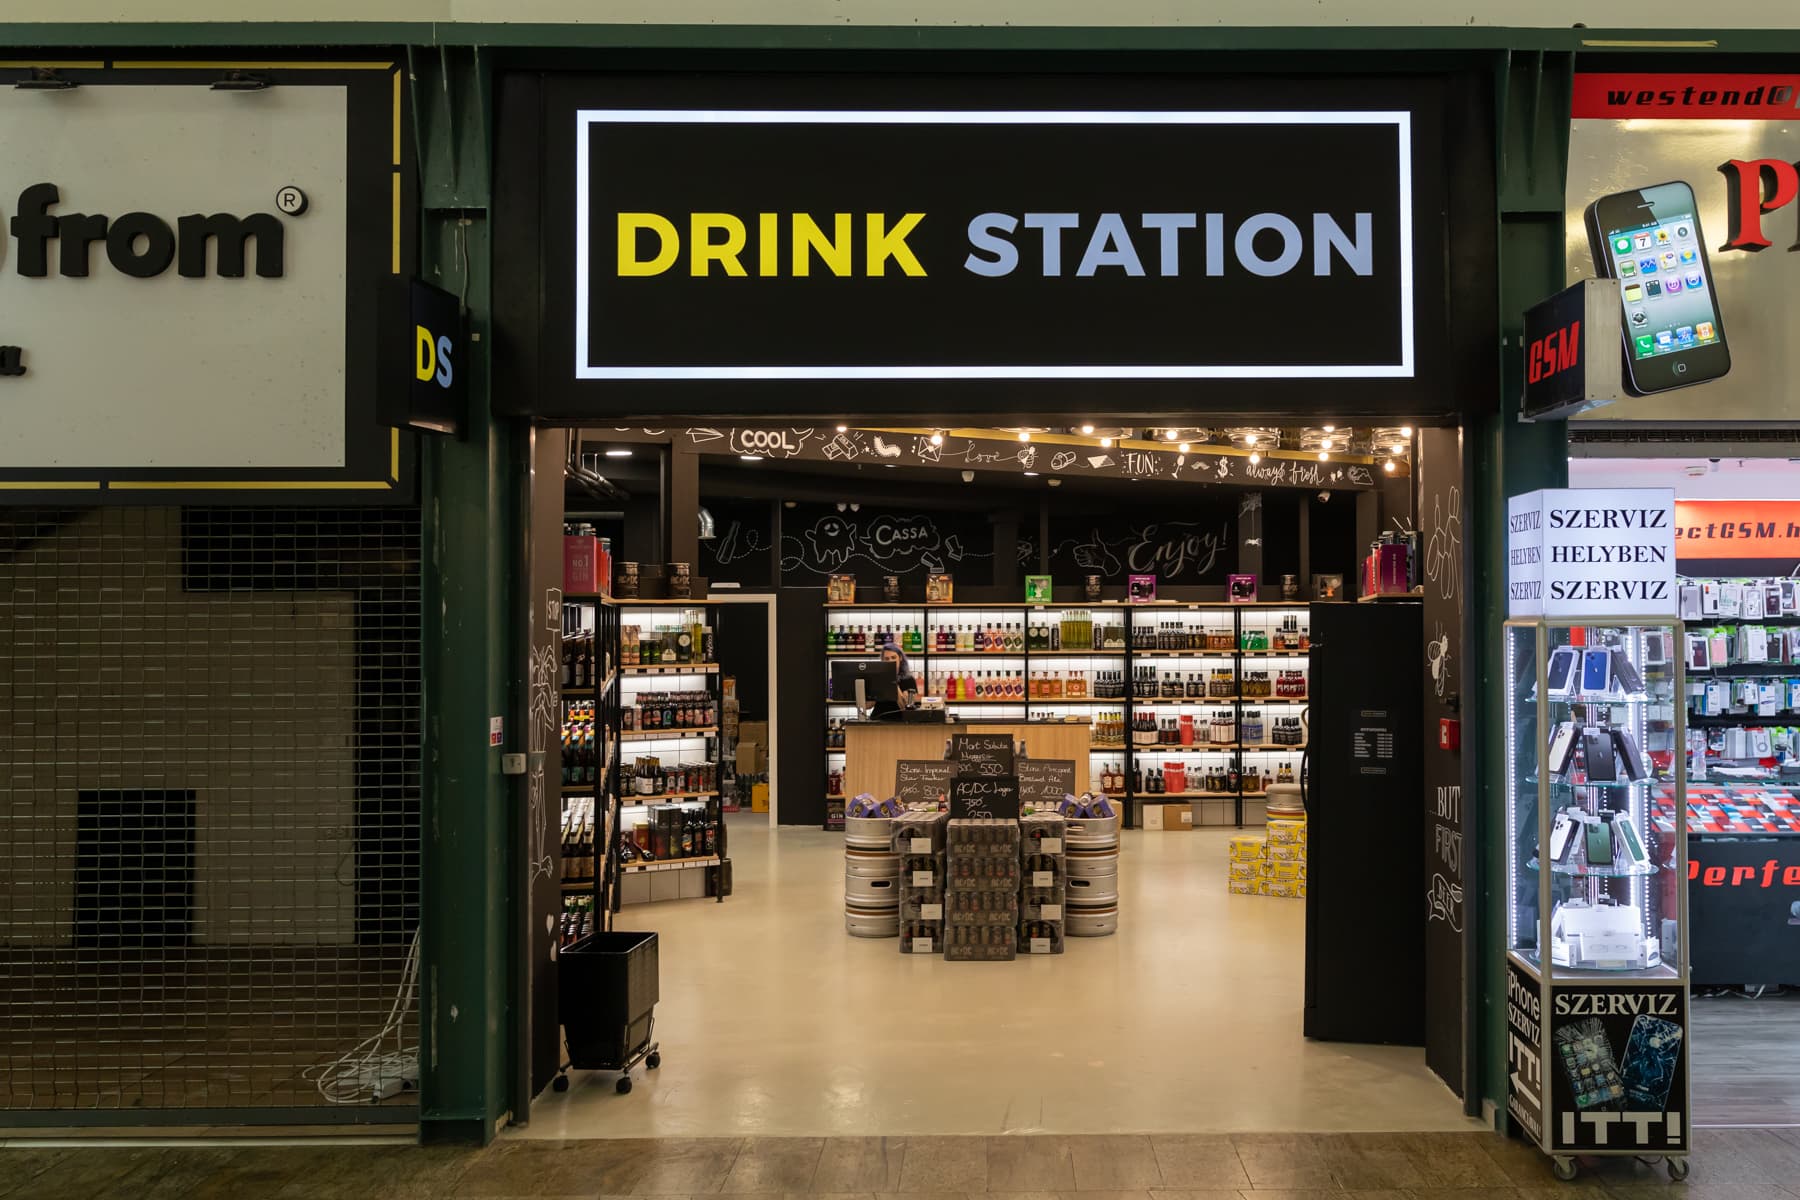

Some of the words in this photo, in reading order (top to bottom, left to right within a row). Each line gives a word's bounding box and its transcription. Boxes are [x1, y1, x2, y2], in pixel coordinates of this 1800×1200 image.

[1717, 158, 1800, 253] P
[617, 212, 927, 277] DRINK
[964, 210, 1373, 278] STATION
[416, 323, 453, 389] DS
[1529, 320, 1580, 385] GSM
[740, 428, 796, 451] COOL
[1126, 452, 1155, 474] FUN
[1510, 510, 1541, 534] SZERVIZ
[1550, 508, 1668, 529] SZERVIZ
[1510, 545, 1541, 567] HELYBEN
[1551, 545, 1666, 563] HELYBEN
[1510, 580, 1541, 601] SZERVIZ
[1551, 580, 1668, 600] SZERVIZ
[956, 782, 992, 796] AC/DC
[1437, 785, 1461, 824] BUT
[1435, 823, 1463, 881] FIRST
[1508, 969, 1540, 1021] iPhone
[1555, 993, 1677, 1016] SZERVIZ
[1508, 1001, 1541, 1049] SZERVIZ
[1509, 1030, 1541, 1091] ITT!
[1562, 1111, 1681, 1145] ITT!
